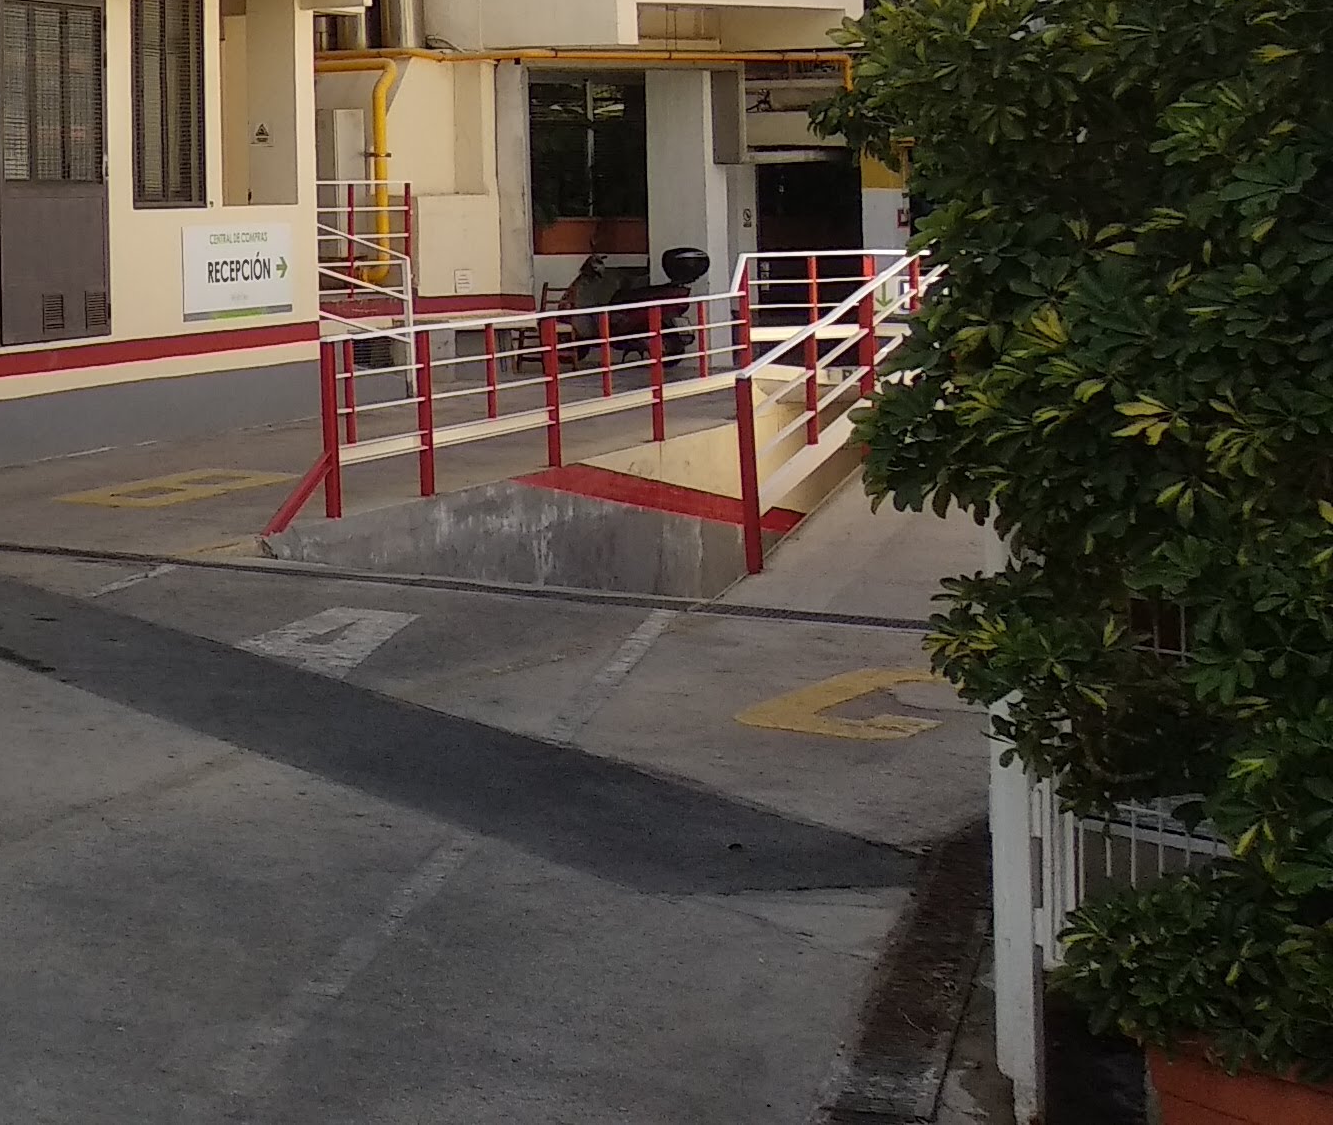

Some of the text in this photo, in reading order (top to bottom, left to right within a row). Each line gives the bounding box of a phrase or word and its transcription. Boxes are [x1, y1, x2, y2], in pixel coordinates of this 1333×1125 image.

[210, 232, 268, 245] CENTRAL DE COMPRAS
[208, 252, 271, 283] RECEPCIÓN
